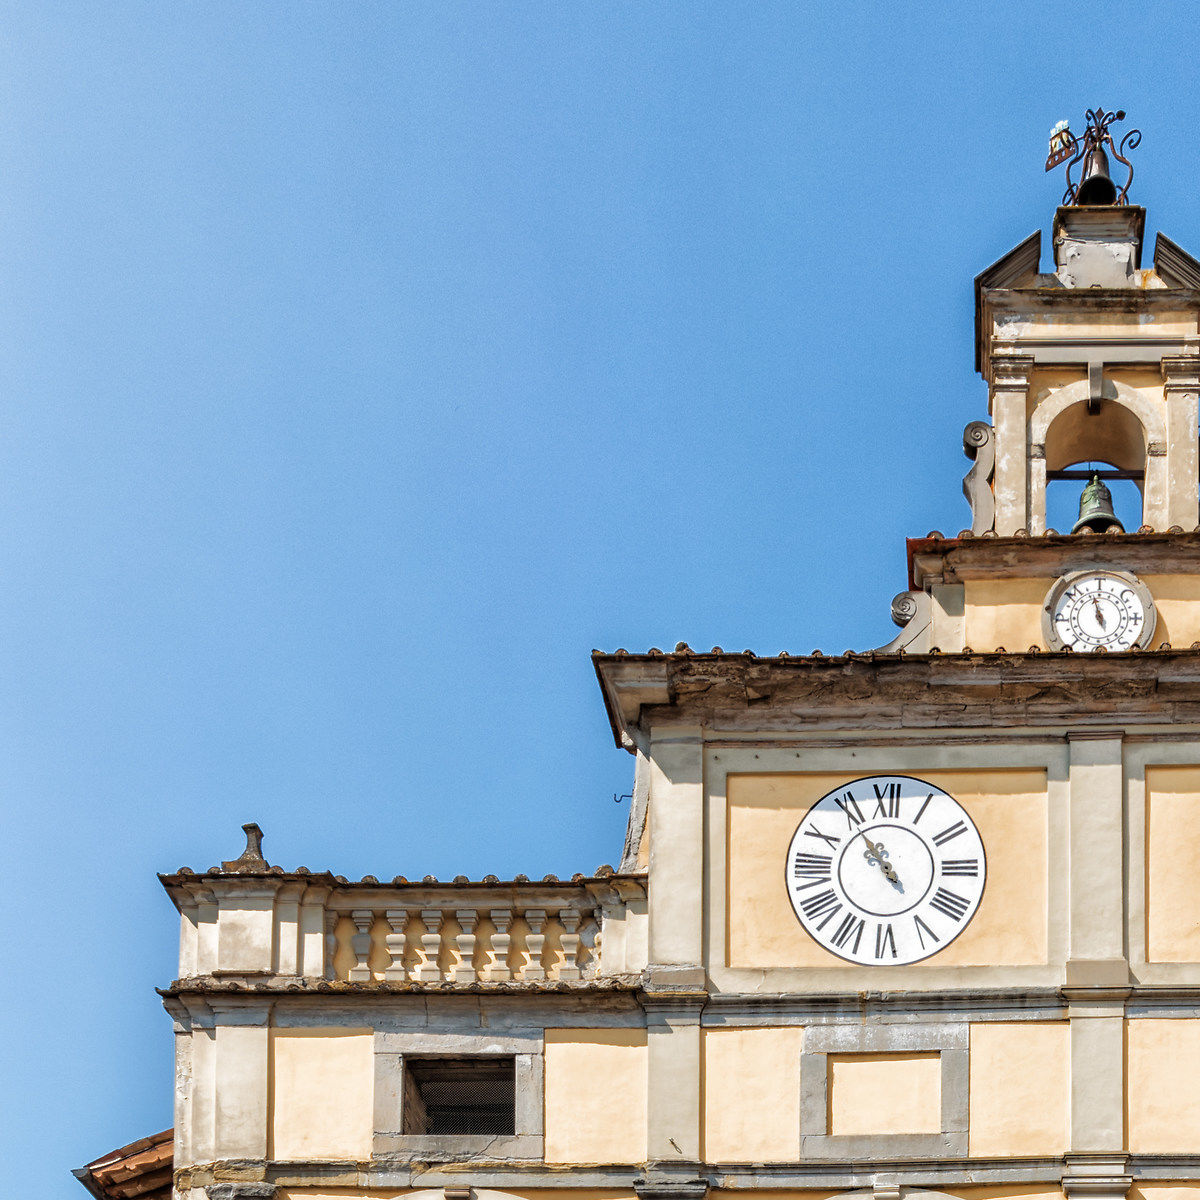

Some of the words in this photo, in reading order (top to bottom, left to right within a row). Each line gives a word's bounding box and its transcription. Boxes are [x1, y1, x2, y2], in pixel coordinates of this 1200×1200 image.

[1064, 585, 1085, 603] M
[1094, 577, 1106, 591] T
[1120, 589, 1135, 604] G
[1055, 612, 1070, 623] P
[1118, 636, 1131, 650] S
[834, 790, 867, 831] XI
[872, 782, 902, 820] XII
[912, 792, 934, 825] I
[803, 822, 841, 851] X
[932, 820, 969, 847] II
[941, 859, 979, 877] III
[799, 888, 844, 932] VIII
[928, 886, 972, 923] IIII
[829, 911, 866, 955] VII
[875, 923, 898, 959] VI
[913, 914, 941, 950] V
